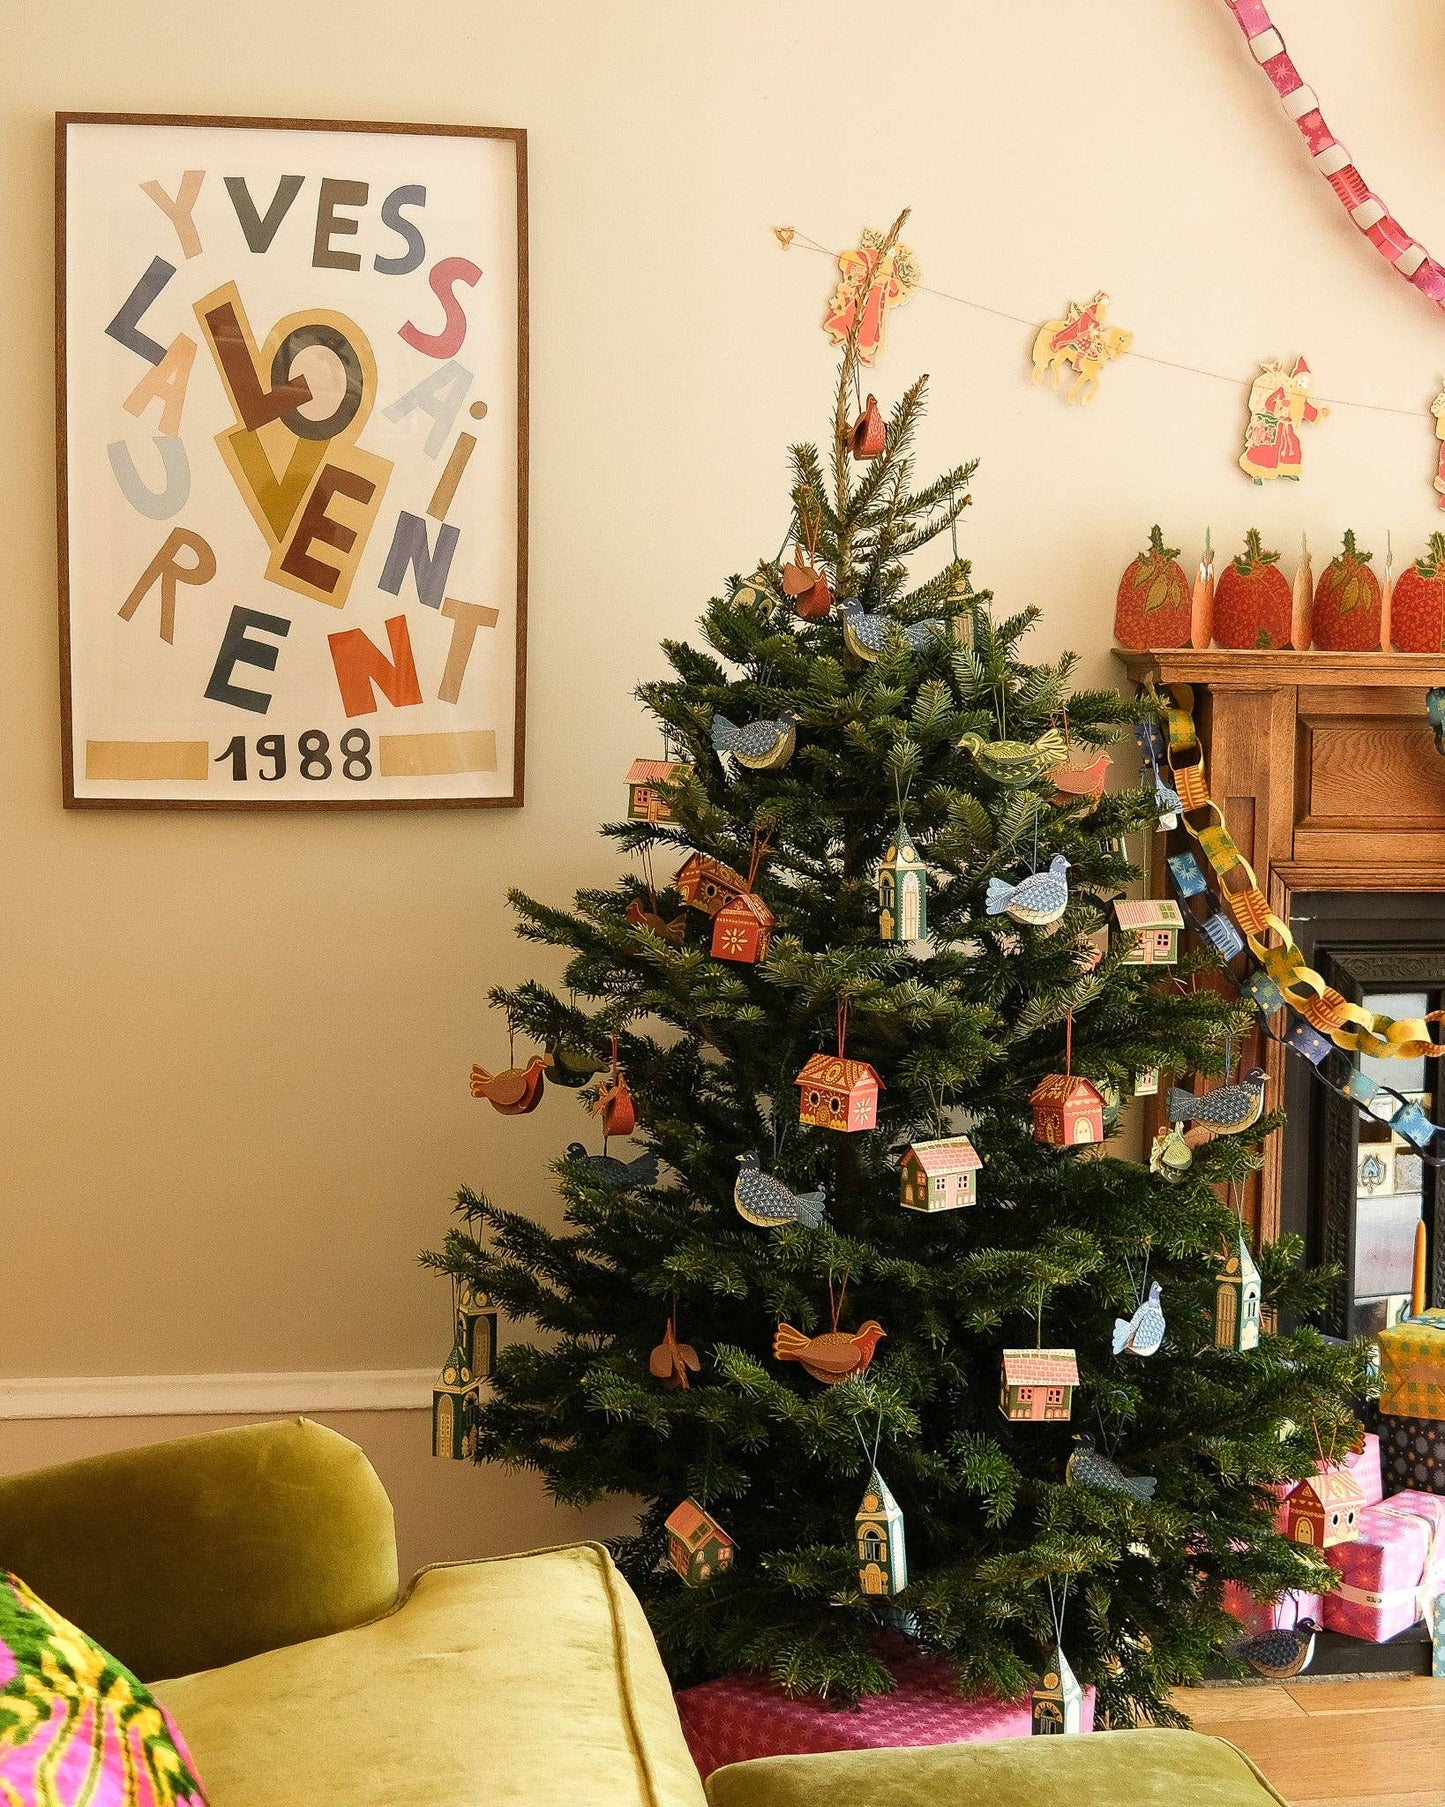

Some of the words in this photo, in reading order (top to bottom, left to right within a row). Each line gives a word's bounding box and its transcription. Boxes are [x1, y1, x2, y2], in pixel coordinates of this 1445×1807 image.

[140, 169, 427, 275] YVES
[204, 301, 376, 593] LOVE
[213, 727, 373, 782] 1988
